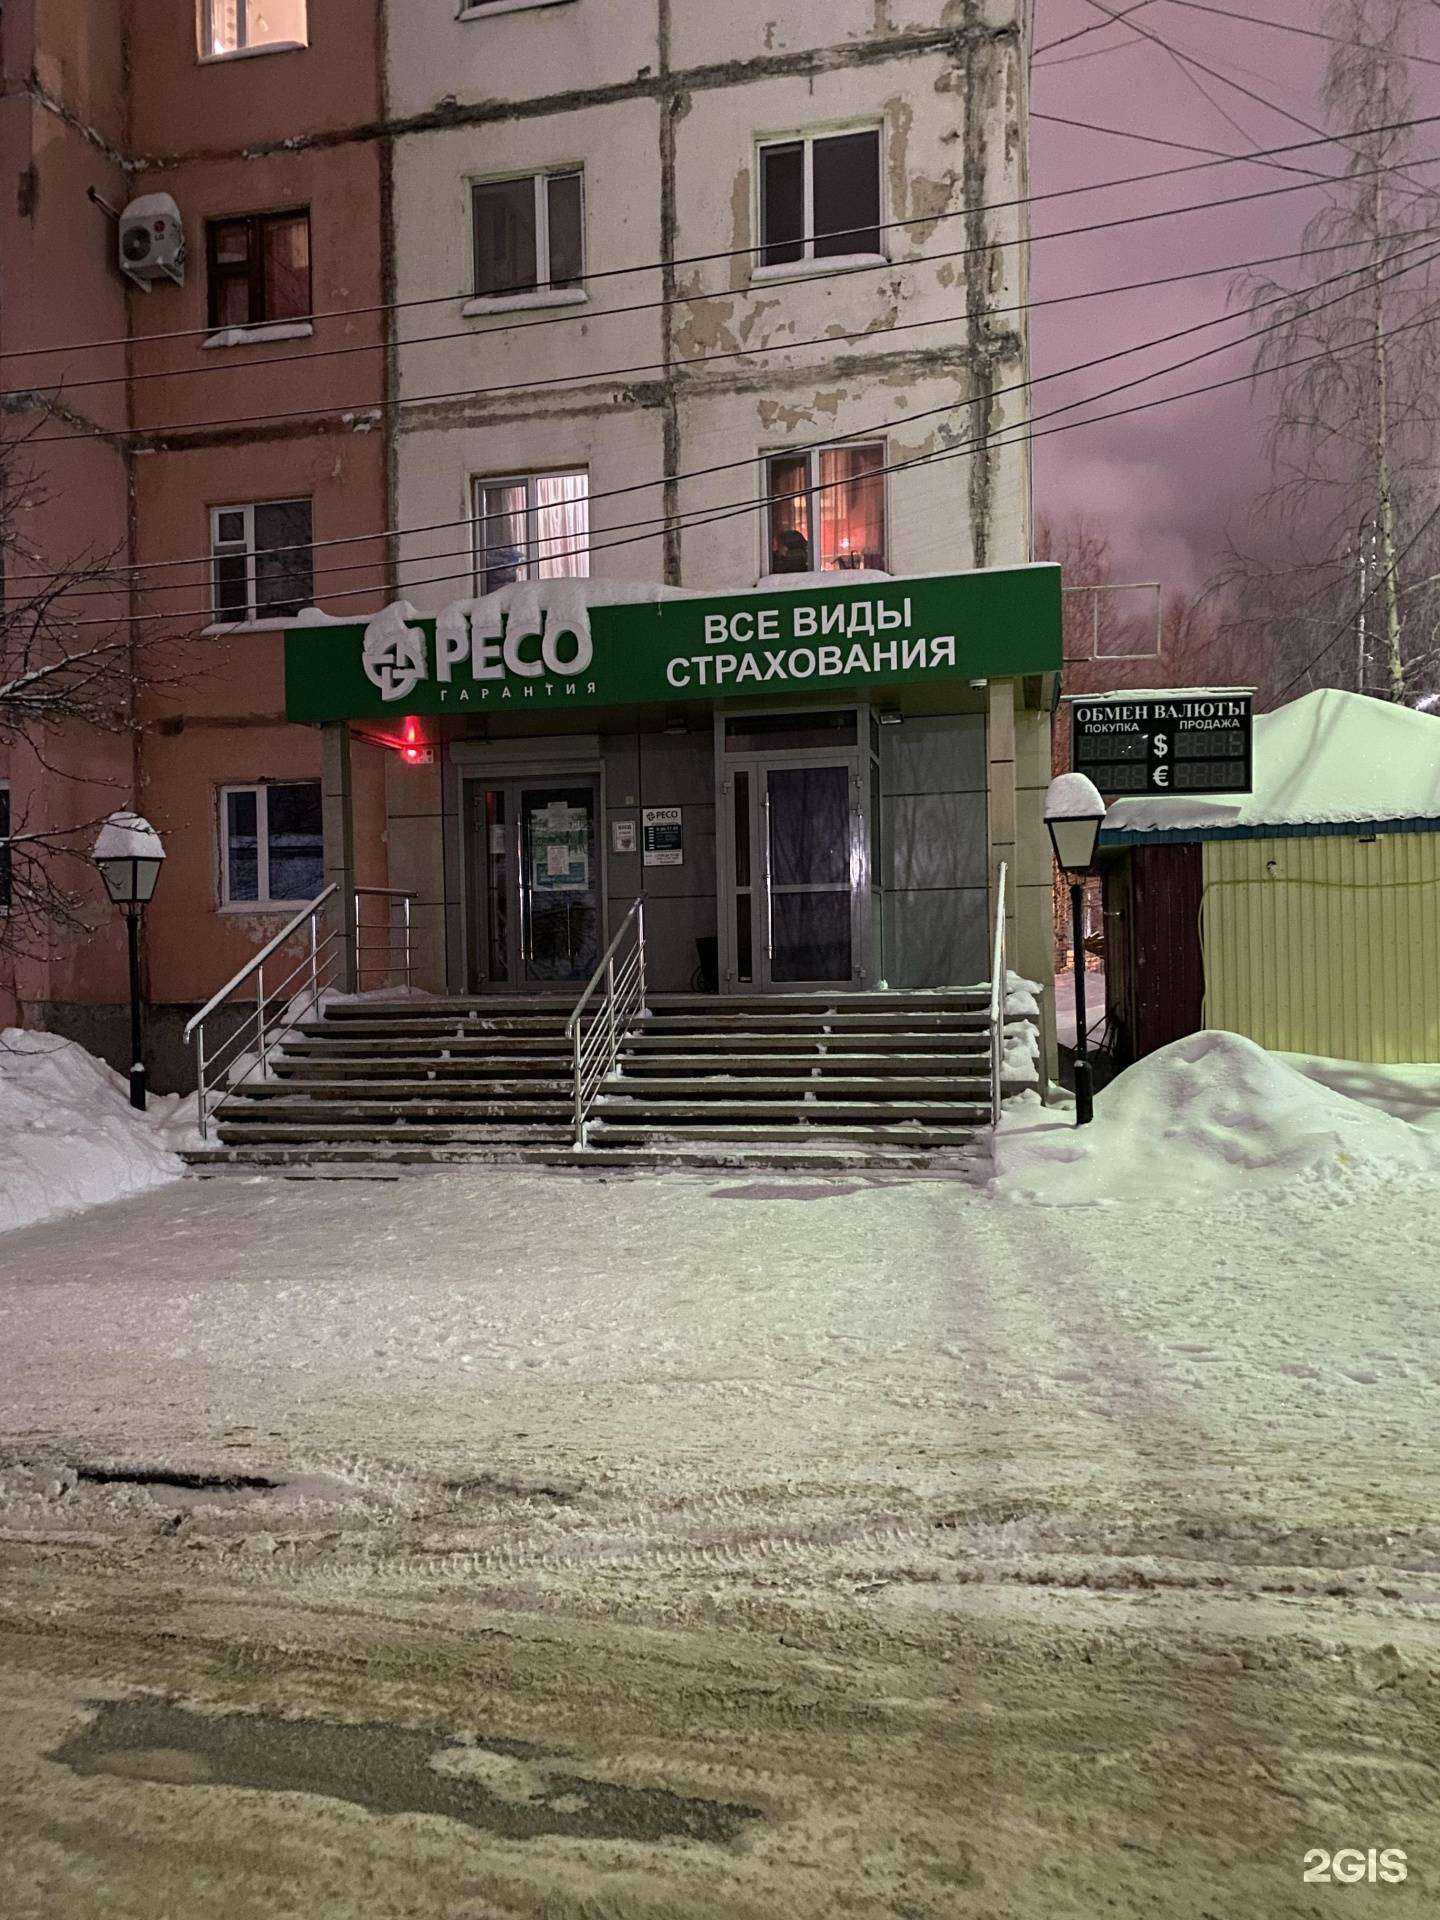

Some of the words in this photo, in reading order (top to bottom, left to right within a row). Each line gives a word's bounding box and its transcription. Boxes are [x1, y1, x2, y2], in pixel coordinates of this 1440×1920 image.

[704, 609, 780, 644] ВСЕ
[793, 597, 912, 637] ВИДЫ
[436, 619, 594, 683] РЕСО
[666, 635, 956, 688] СТРАХОВАНИЯ
[440, 681, 597, 702] ГАРАНТИЯ
[1077, 706, 1148, 722] ОБМЕН
[1153, 701, 1246, 719] ВАЛЮТЫ
[1085, 722, 1139, 733] ПОКУПКА
[1179, 718, 1240, 730] ПРОДАЖА
[1153, 733, 1168, 758] $
[1152, 765, 1169, 787] €
[656, 810, 678, 819] РЕСО
